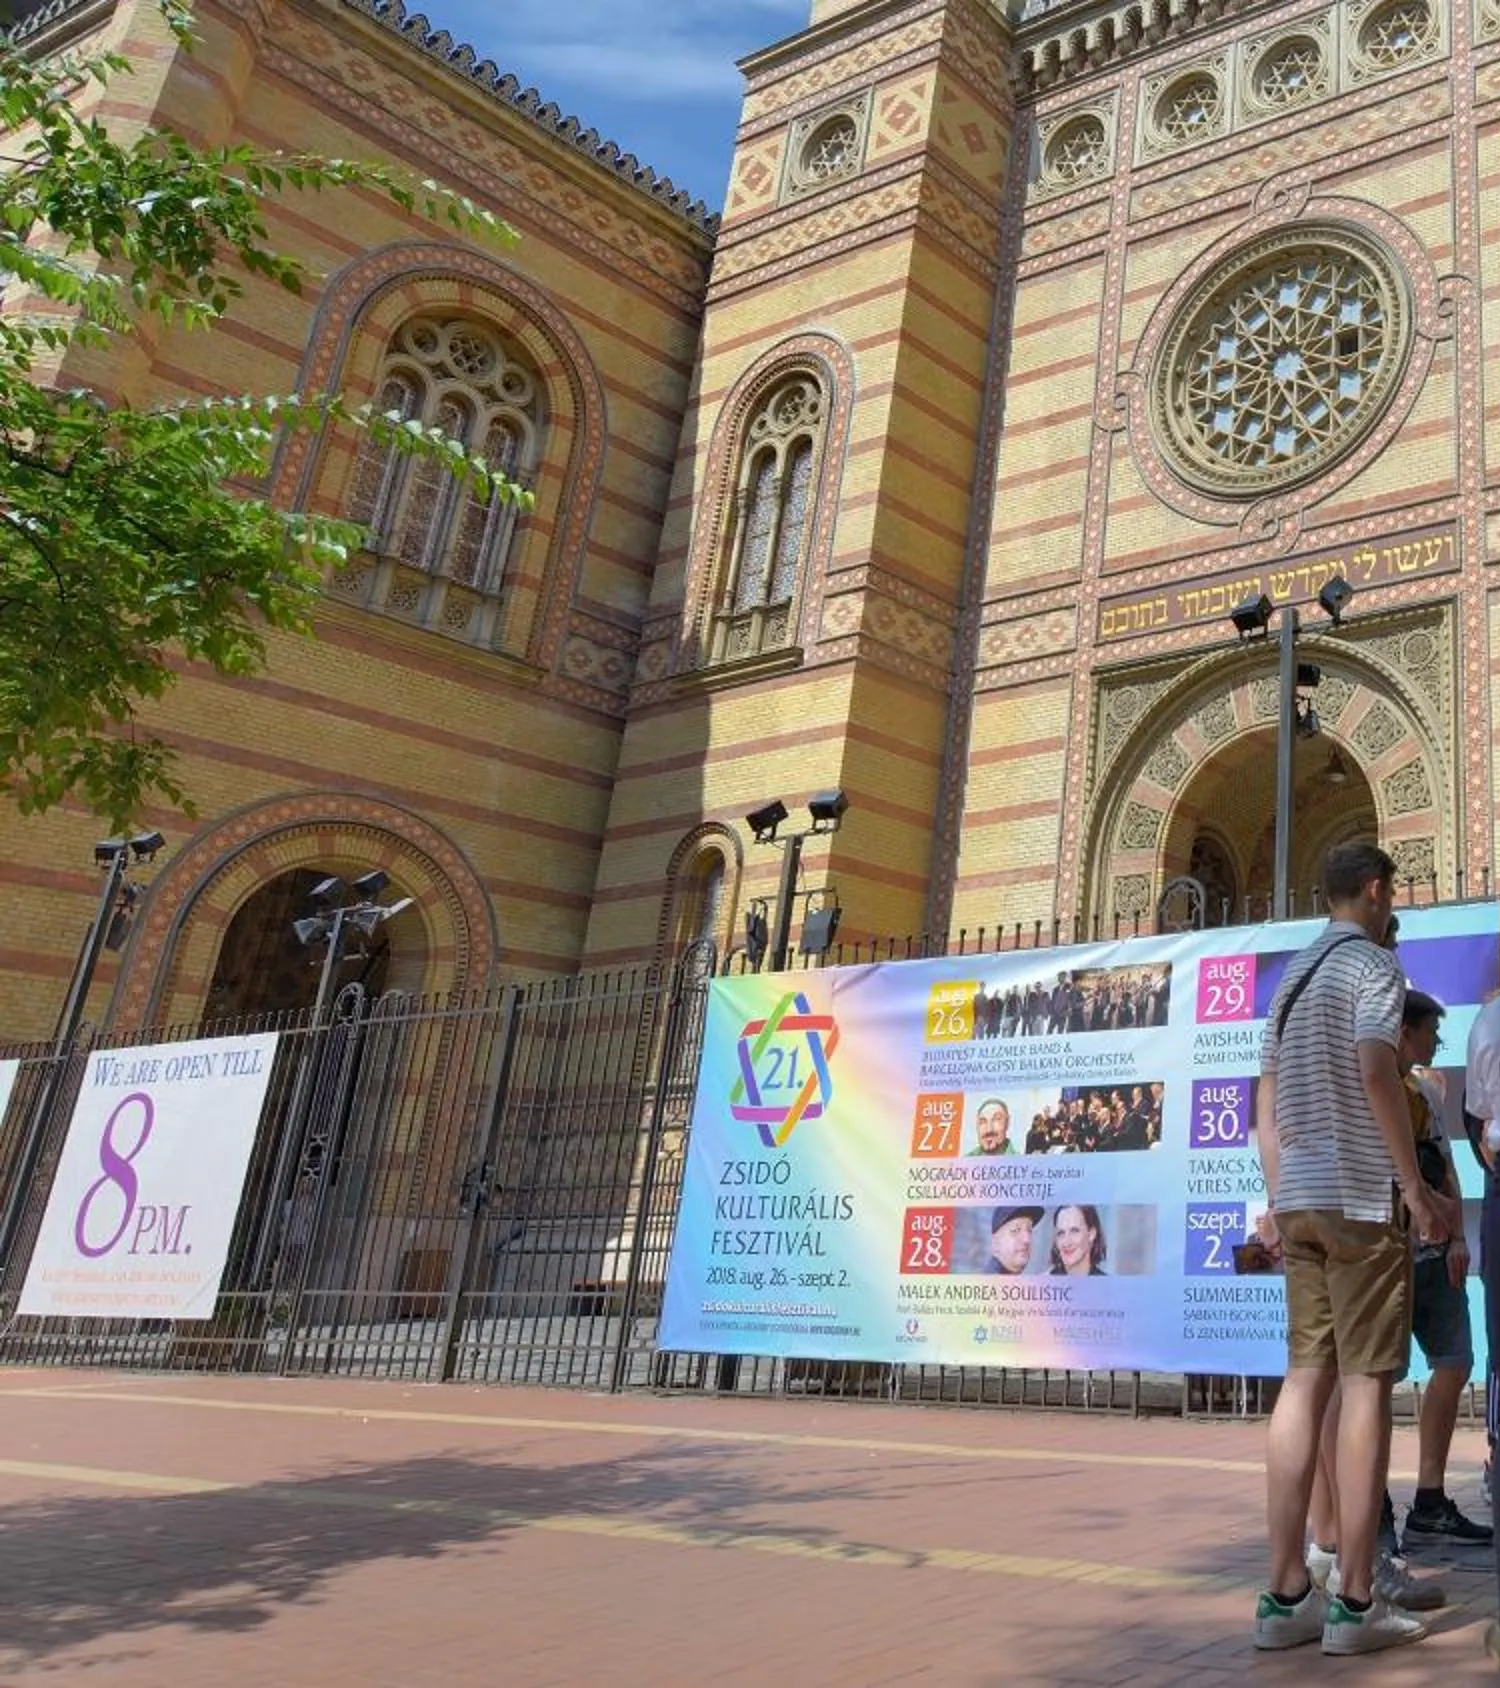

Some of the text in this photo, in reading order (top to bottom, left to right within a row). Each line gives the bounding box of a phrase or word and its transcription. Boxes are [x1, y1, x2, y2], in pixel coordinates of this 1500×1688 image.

[1352, 544, 1377, 580] לי
[1382, 533, 1454, 576] ועשו
[1101, 597, 1169, 636] בתוכם
[1207, 961, 1250, 984] aug.
[1204, 985, 1251, 1018] 29.
[931, 1007, 969, 1036] 26.
[124, 1058, 159, 1085] ARE
[165, 1052, 218, 1081] OPEN
[222, 1049, 264, 1077] TILL
[761, 1046, 804, 1090] 21.
[922, 1099, 957, 1122] aug.
[1199, 1085, 1244, 1109] aug.
[917, 1121, 954, 1152] 27.
[1197, 1109, 1245, 1142] 30.
[75, 1091, 156, 1258] 8
[127, 1204, 193, 1256] PM.
[719, 1153, 792, 1186] ZSIDÓ
[980, 1182, 1056, 1201] KONCERTJE
[1186, 1178, 1233, 1194] VERES
[715, 1187, 855, 1221] KULTURÁLIS
[911, 1213, 948, 1237] aug.
[1187, 1211, 1245, 1235] szept.
[711, 1222, 827, 1257] FESZTIVÁL
[907, 1237, 948, 1268] 28.
[1202, 1235, 1231, 1269] 2.
[897, 1283, 1074, 1302] MALEK ANDREA SOULISTIC
[1183, 1287, 1286, 1303] SUMMERTIM
